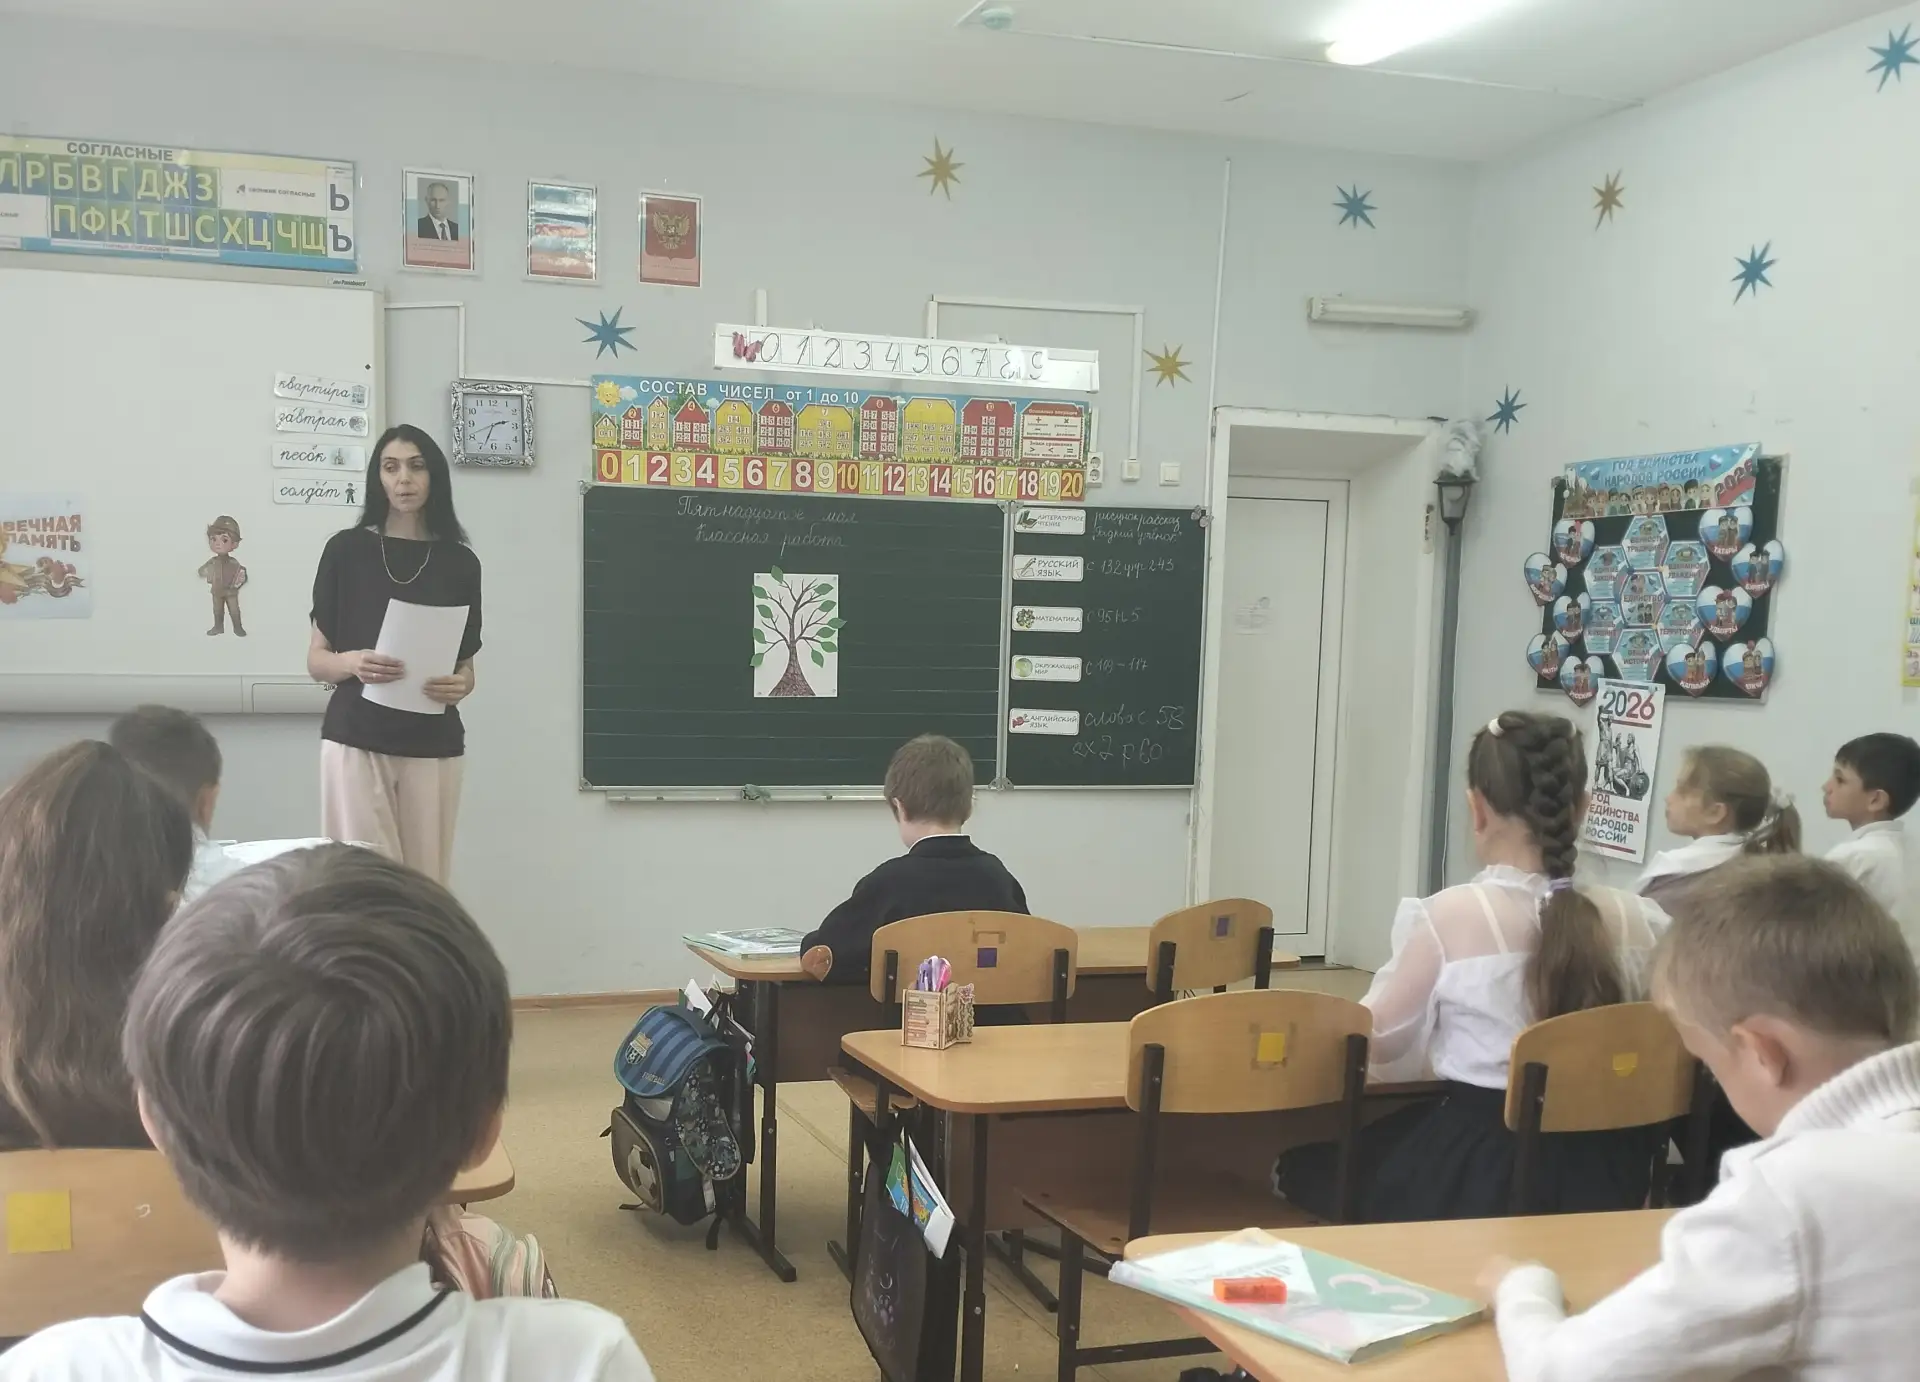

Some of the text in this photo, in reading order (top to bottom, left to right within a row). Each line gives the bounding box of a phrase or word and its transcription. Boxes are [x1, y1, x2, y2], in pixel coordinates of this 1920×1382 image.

[66, 142, 174, 162] СОГЛАСНЫЕ
[25, 160, 46, 189] Р
[53, 162, 74, 191] Б
[82, 164, 103, 193] В
[112, 166, 128, 195] Г
[137, 169, 162, 202] Д
[164, 170, 190, 200] Ж
[195, 173, 214, 202] З
[329, 183, 350, 212] Ь
[53, 204, 326, 255] П Ф К Т Ш С Х Ц Ч Щ
[328, 224, 353, 253] Ъ
[760, 332, 779, 362] 0
[796, 335, 810, 365] 1
[824, 338, 842, 369] 2
[853, 341, 871, 371] 3
[886, 342, 900, 373] 4
[912, 344, 930, 374] 5
[941, 346, 959, 376] 6
[972, 347, 988, 378] 7
[639, 380, 859, 405] СОСТАВ ЧИСЕЛ от 1 до 10
[601, 452, 1083, 498] 0 1 2 3 4 5 6 7 8 9 10 11 12 13 14 15 16 17 18 19 20
[1604, 466, 1707, 487] НАРОДОВ РОССИИ
[1612, 460, 1635, 473] ГОД
[3, 514, 82, 533] ВЕЧНАЯ
[780, 522, 849, 556] работа
[1037, 560, 1079, 569] РУССКИЙ
[1602, 690, 1656, 721] 2026
[1592, 790, 1610, 805] ГОД
[1588, 816, 1634, 834] НАРОДОВ
[1589, 804, 1640, 824] ЕДИНСТВА
[1586, 827, 1627, 844] РОССИИ
